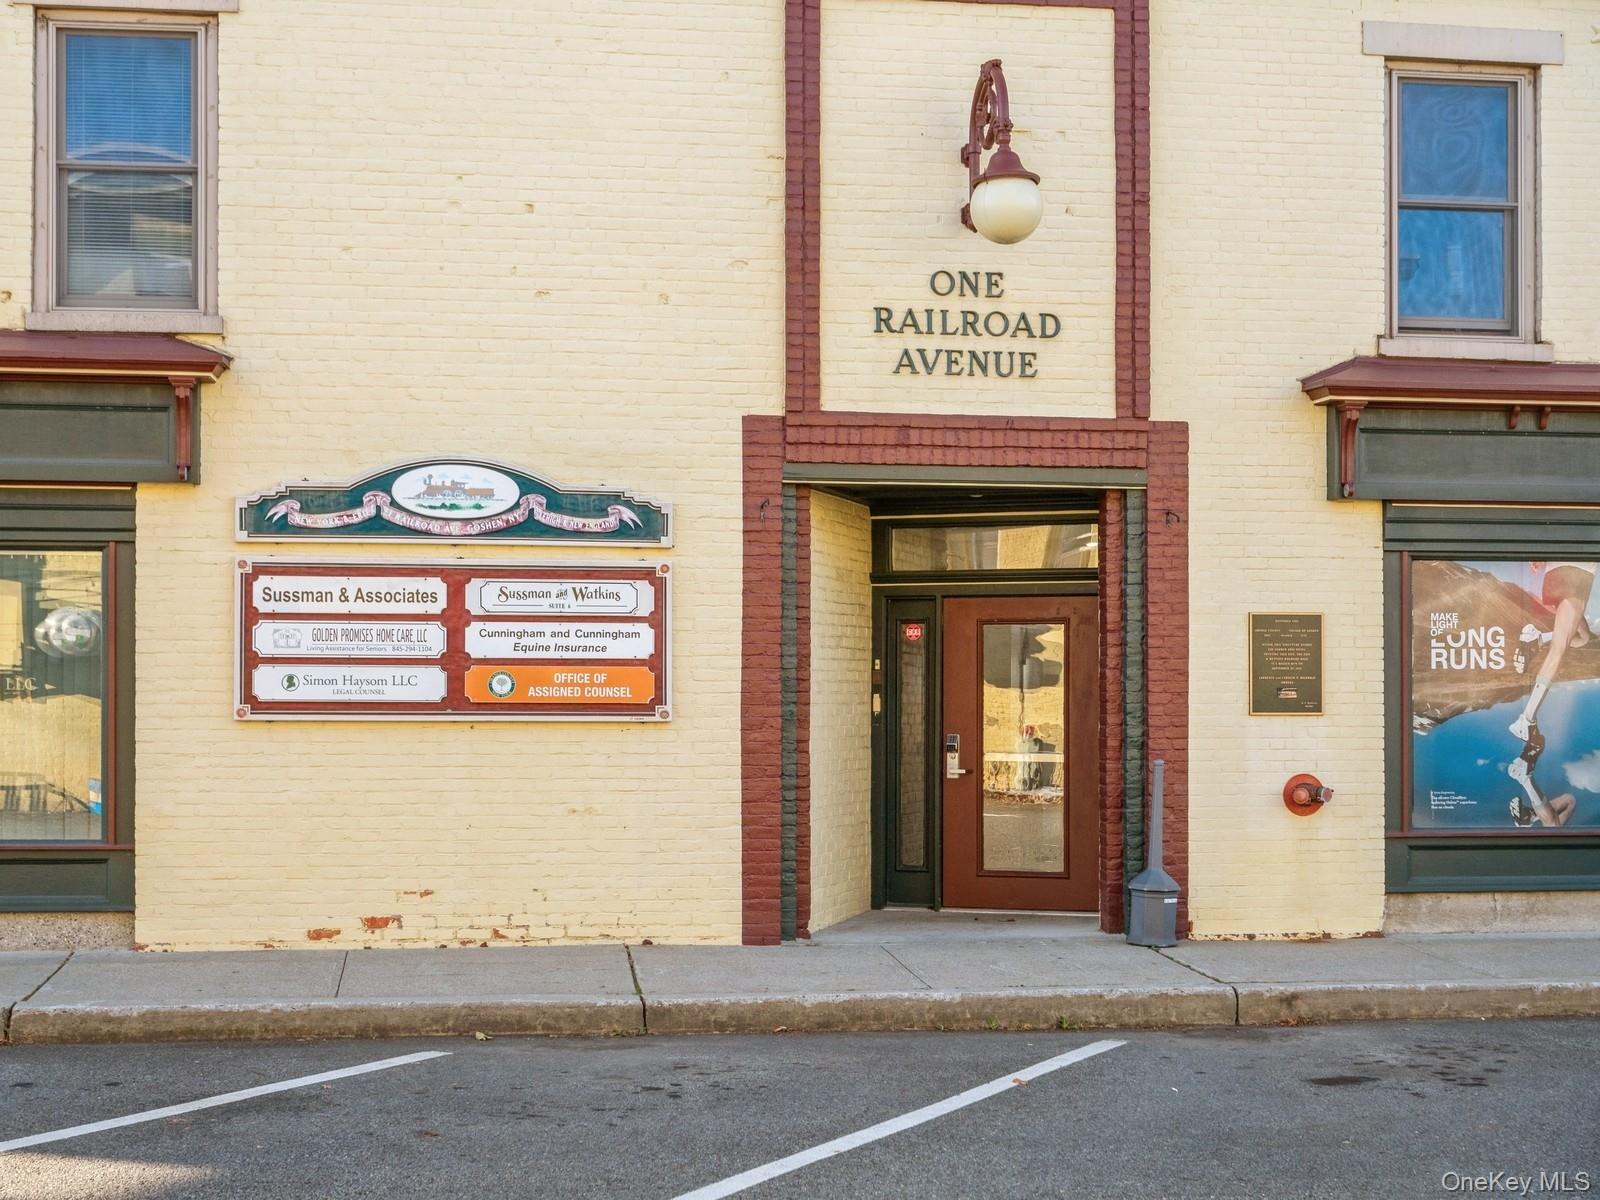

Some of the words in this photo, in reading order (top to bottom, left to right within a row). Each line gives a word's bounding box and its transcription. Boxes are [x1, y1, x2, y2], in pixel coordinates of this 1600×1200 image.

[930, 270, 1004, 298] ONE
[873, 306, 1062, 339] RAILROAD
[892, 348, 1038, 378] AVENUE
[295, 516, 312, 525] NEW
[318, 517, 338, 525] YORK
[395, 513, 440, 531] RAILROAD
[467, 518, 506, 533] GOSHEN,
[508, 513, 521, 522] NY
[262, 586, 333, 603] Sussman
[338, 587, 349, 603] &
[354, 588, 438, 604] Associates
[498, 586, 552, 602] Sussman
[555, 588, 568, 600] and
[572, 586, 621, 601] Watkins
[1430, 612, 1459, 621] MAKE
[1430, 620, 1459, 629] LIGHT
[312, 627, 339, 642] GOLDEN
[341, 628, 374, 642] PROMISES
[376, 628, 395, 643] HOME
[396, 628, 415, 644] CARE,
[416, 628, 428, 643] LLC
[479, 629, 546, 640] Cunningham
[550, 629, 570, 639] and
[574, 629, 641, 641] Cunningham
[1430, 628, 1443, 637] OF
[306, 645, 324, 653] Living
[513, 643, 551, 655] Equine
[554, 643, 608, 653] Insurance
[1430, 648, 1505, 670] RUNS
[302, 675, 338, 687] Simon
[343, 675, 388, 689] Haysom
[392, 675, 418, 687] LLC
[553, 673, 592, 684] OFFICE
[594, 673, 607, 684] OF
[528, 687, 582, 697] ASSIGNED
[584, 687, 632, 697] COUNSEL
